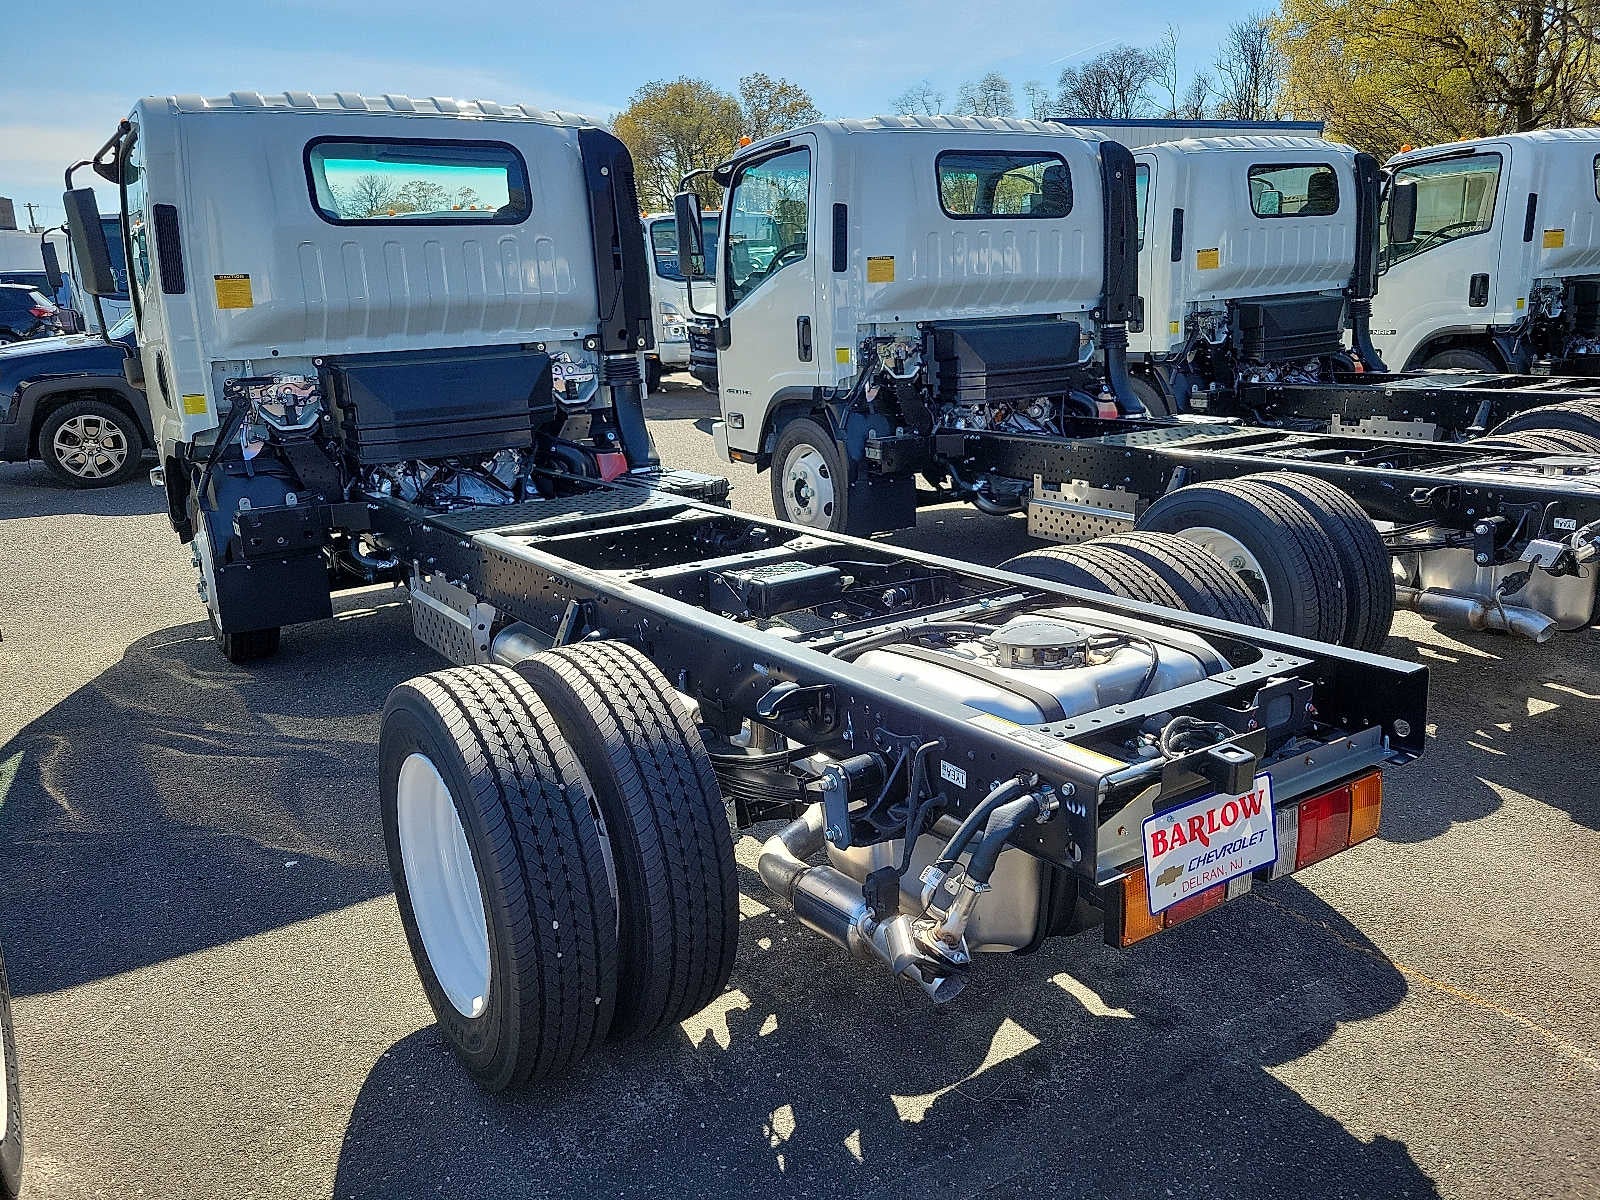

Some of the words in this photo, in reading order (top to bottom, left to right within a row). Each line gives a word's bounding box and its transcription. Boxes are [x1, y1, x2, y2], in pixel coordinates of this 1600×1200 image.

[1151, 789, 1265, 858] BARLOW
[1187, 829, 1268, 873] CHEVROLET
[1182, 864, 1229, 893] DELRAN,
[1230, 857, 1244, 871] NJ
